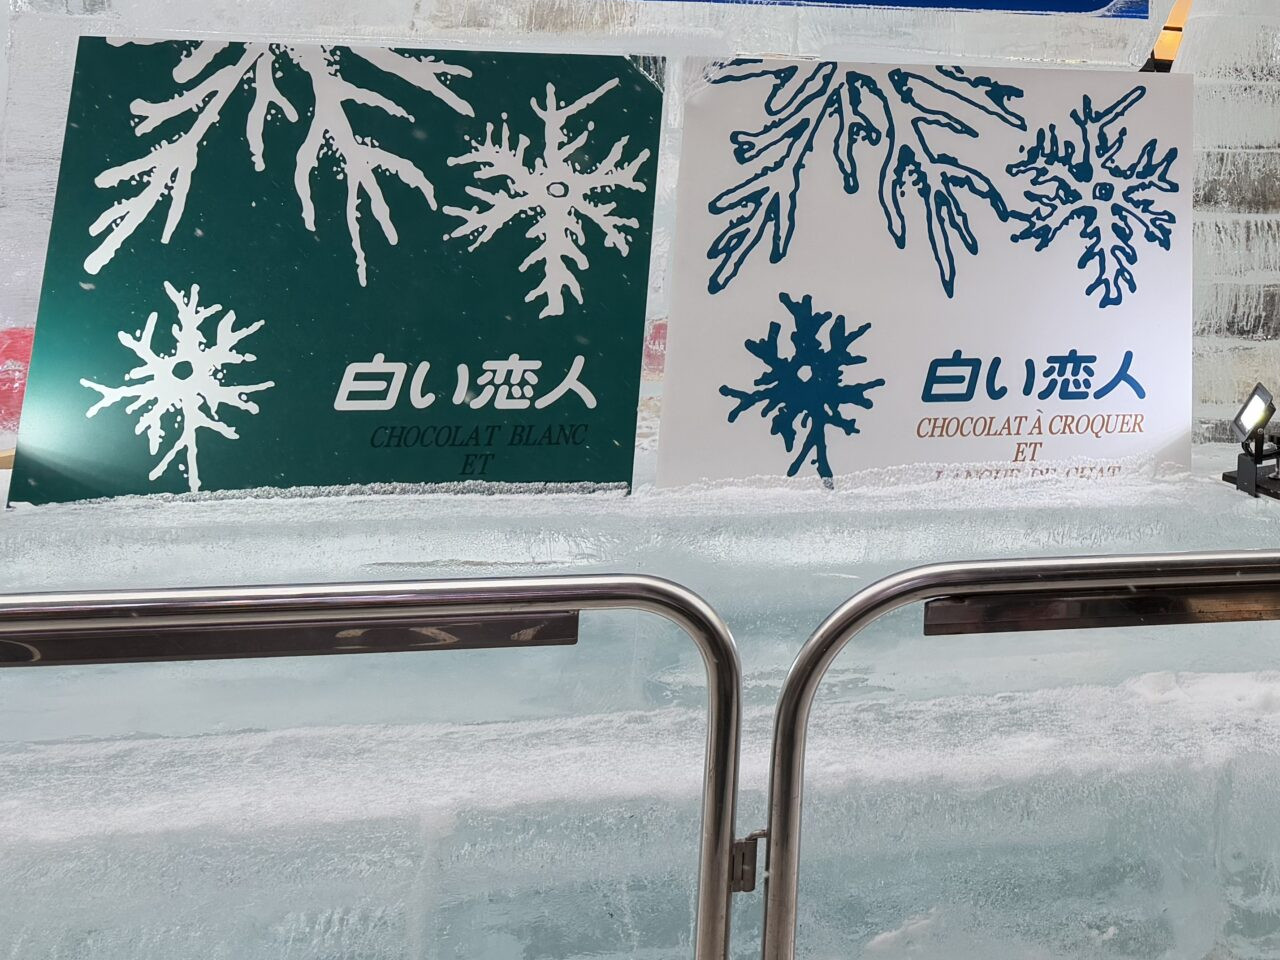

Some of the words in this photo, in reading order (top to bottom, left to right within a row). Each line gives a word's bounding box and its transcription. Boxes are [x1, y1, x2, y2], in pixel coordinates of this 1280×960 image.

[334, 353, 598, 411] 白い恋人
[921, 349, 1146, 402] 白い恋人
[369, 425, 501, 449] CHOCOLAT
[508, 423, 589, 447] BLANC
[916, 416, 1028, 438] CHOCOLAT
[1048, 413, 1145, 438] CROQUER
[458, 453, 495, 476] ET
[1012, 442, 1043, 463] ET
